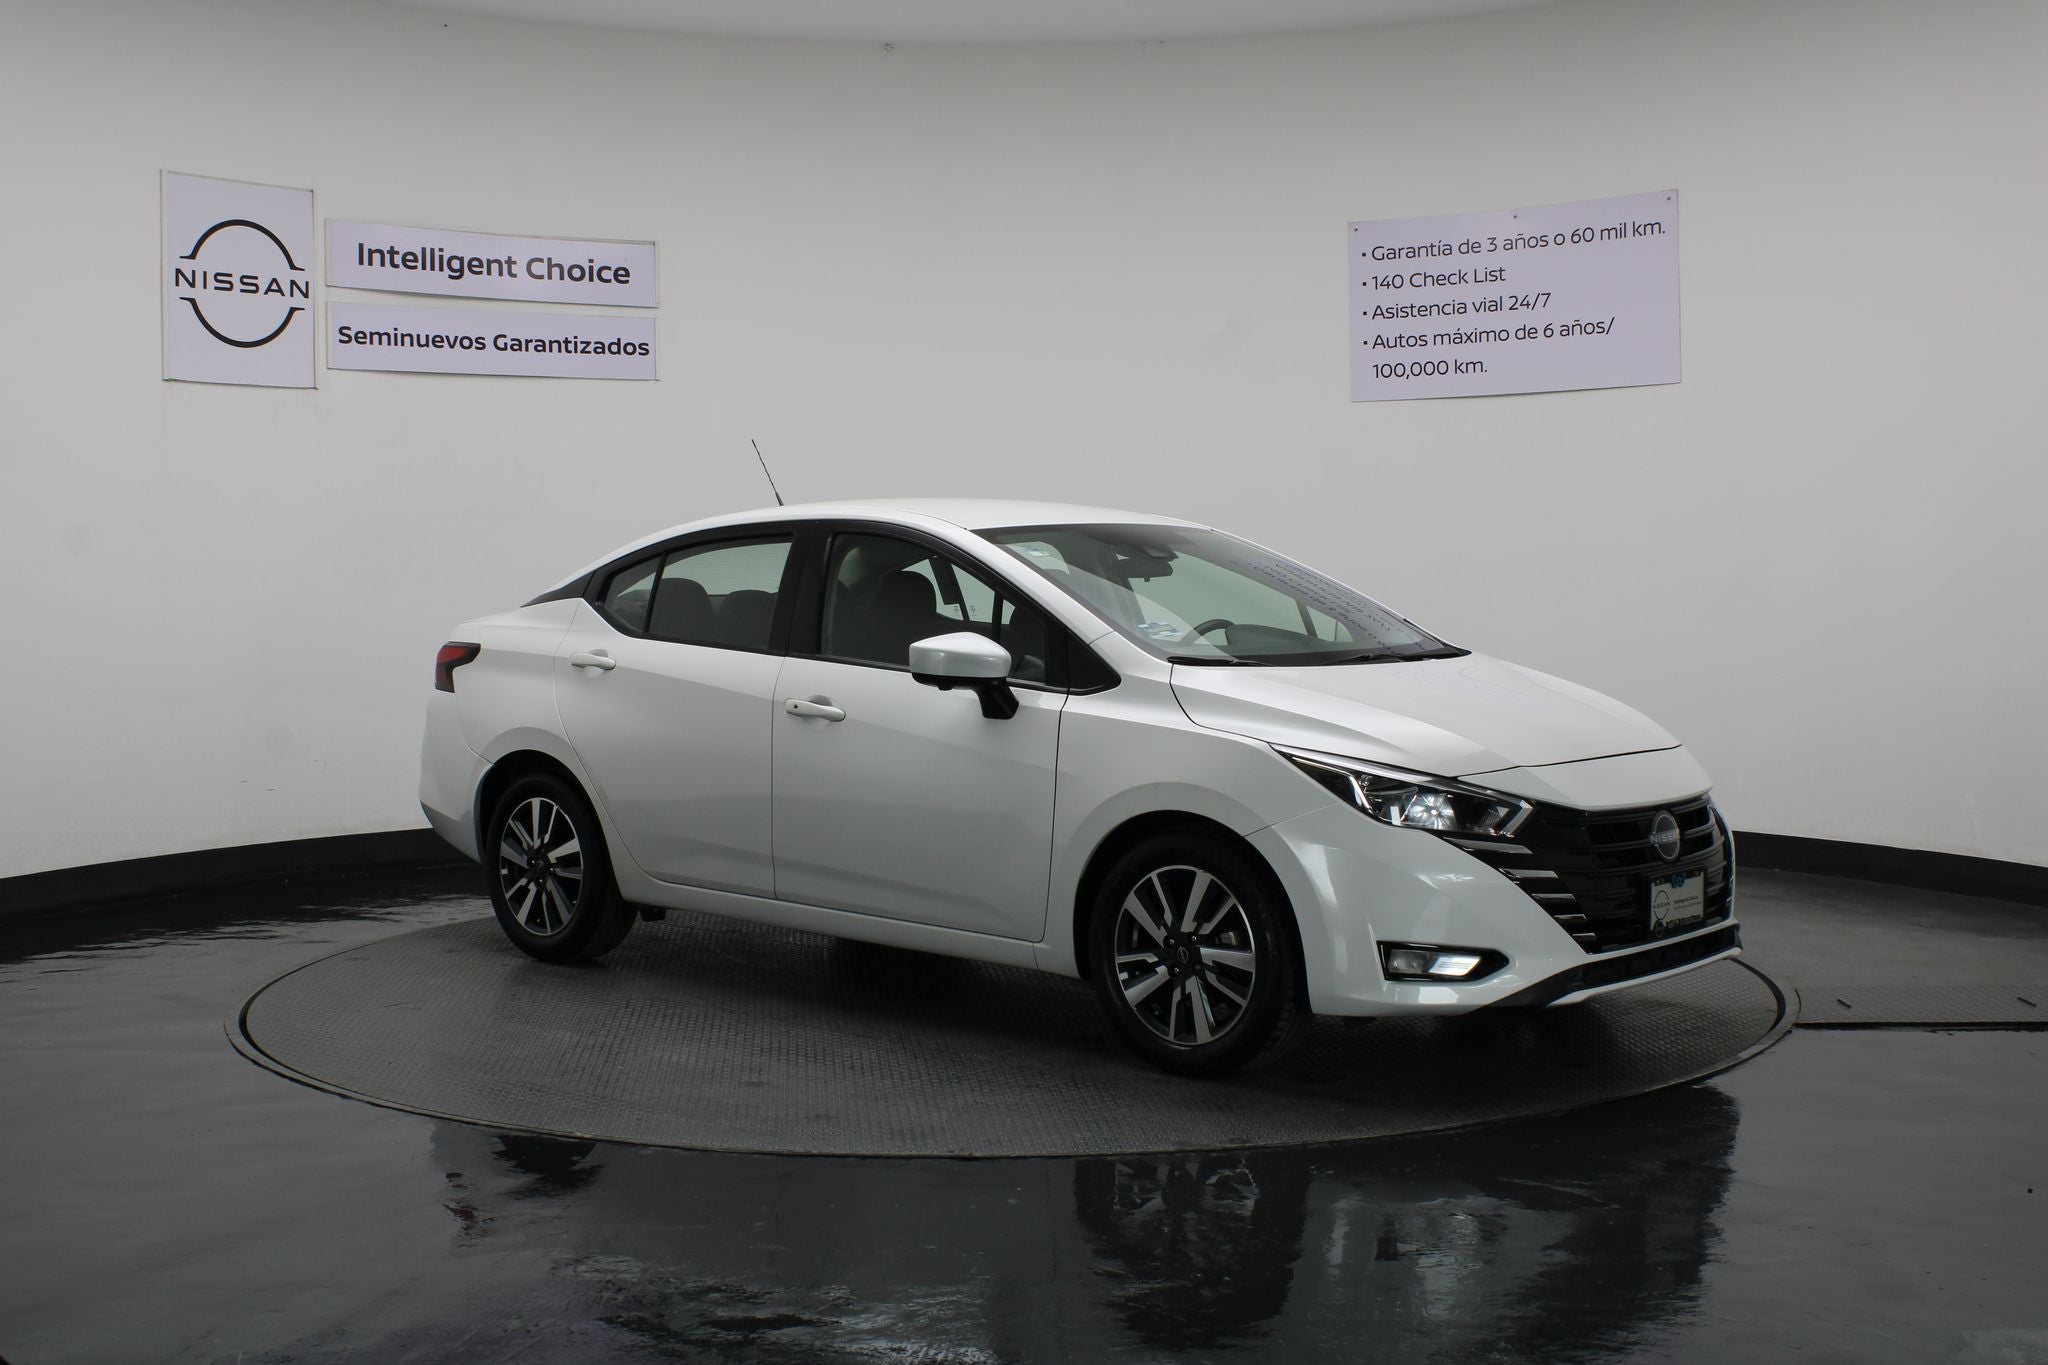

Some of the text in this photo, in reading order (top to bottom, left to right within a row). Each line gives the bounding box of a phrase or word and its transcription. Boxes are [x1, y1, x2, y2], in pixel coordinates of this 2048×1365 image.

[1371, 220, 1666, 262] Garantía de 3 años o 60 mil km.
[357, 241, 631, 285] Intelligent Choice
[1371, 265, 1507, 291] 140 Check List
[174, 267, 310, 300] NISSAN
[1371, 292, 1552, 321] Asistencia vial 24/7
[337, 325, 650, 357] Seminuevos Garantizados
[1371, 316, 1616, 350] Autos máximo de 6 años/
[1372, 358, 1489, 380] 100,000 km.
